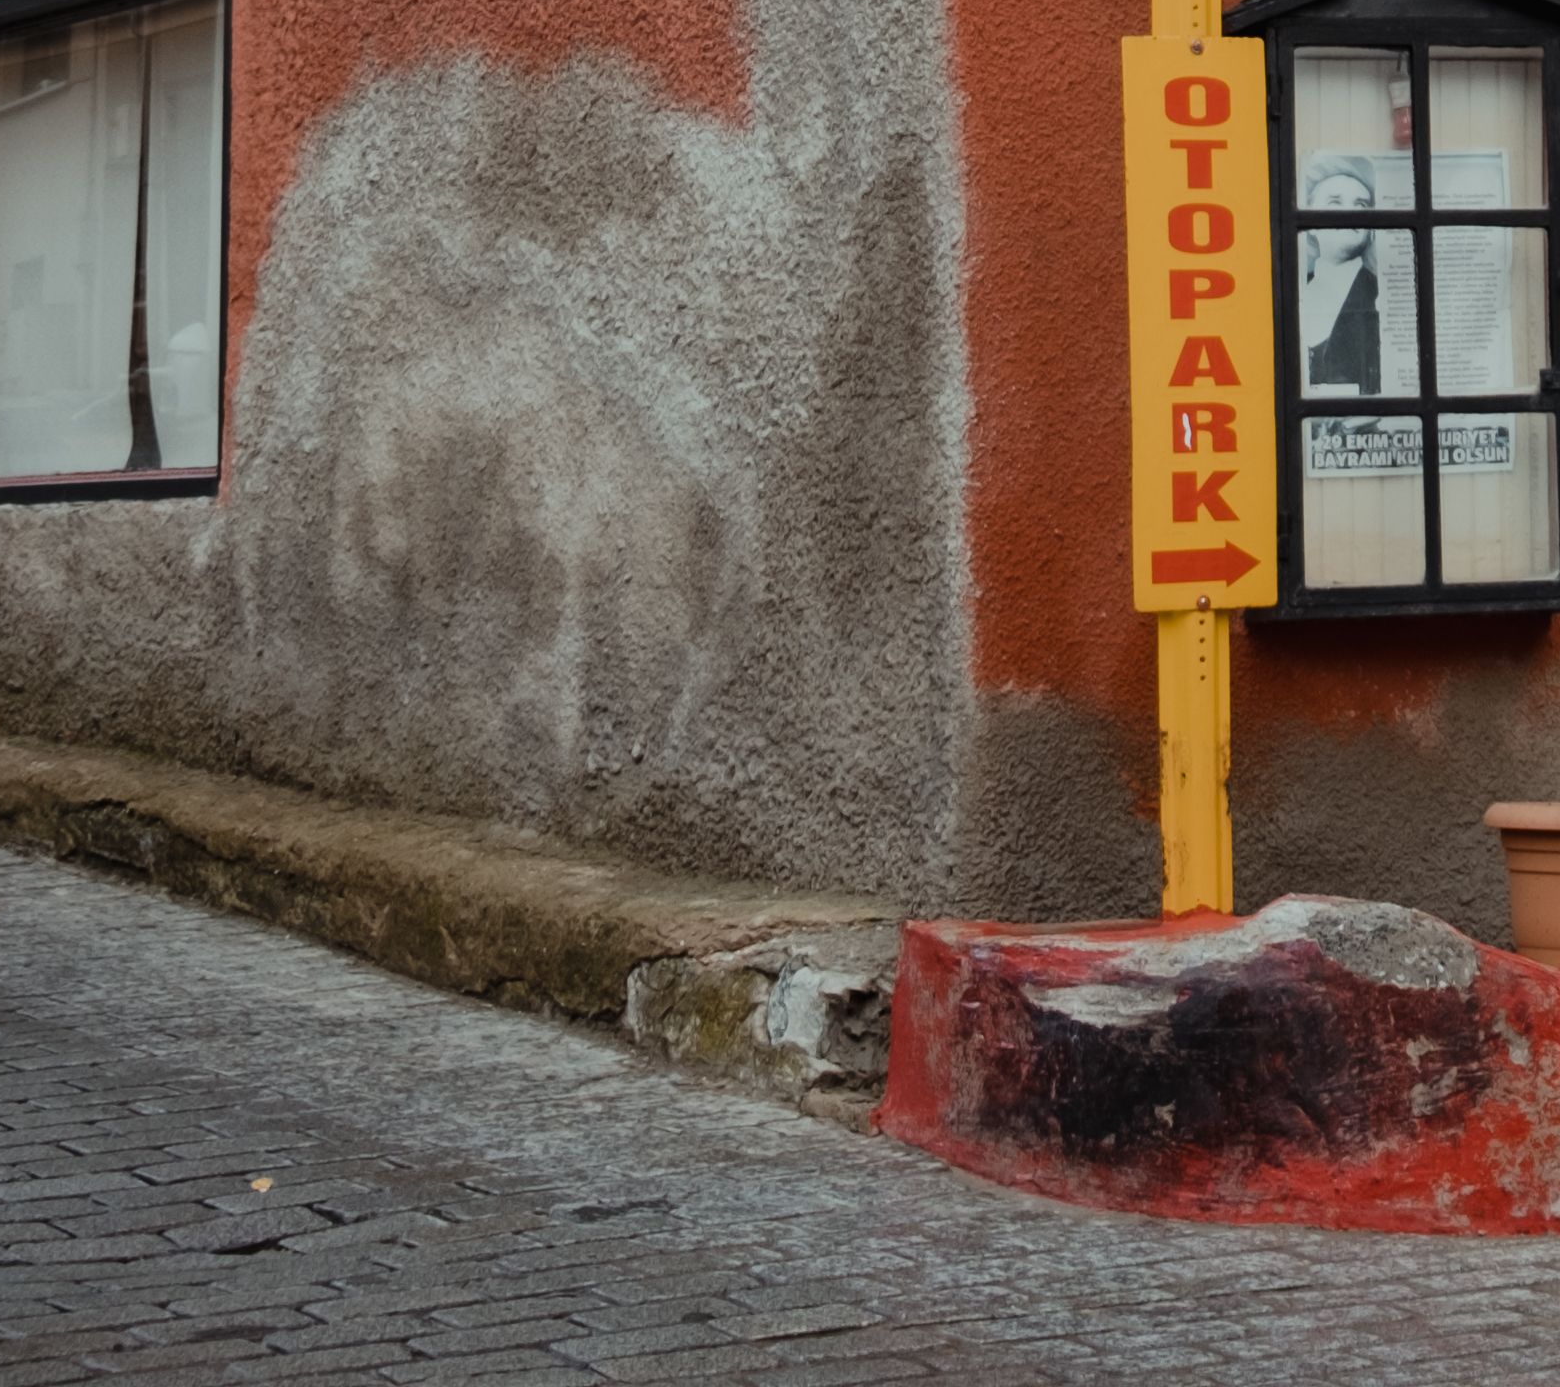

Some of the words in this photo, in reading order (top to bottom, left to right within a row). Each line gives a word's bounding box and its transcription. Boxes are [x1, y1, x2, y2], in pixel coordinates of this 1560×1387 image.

[1163, 75, 1243, 524] OTOPARK
[1321, 433, 1343, 451] 29
[1452, 446, 1508, 463] OLSUN
